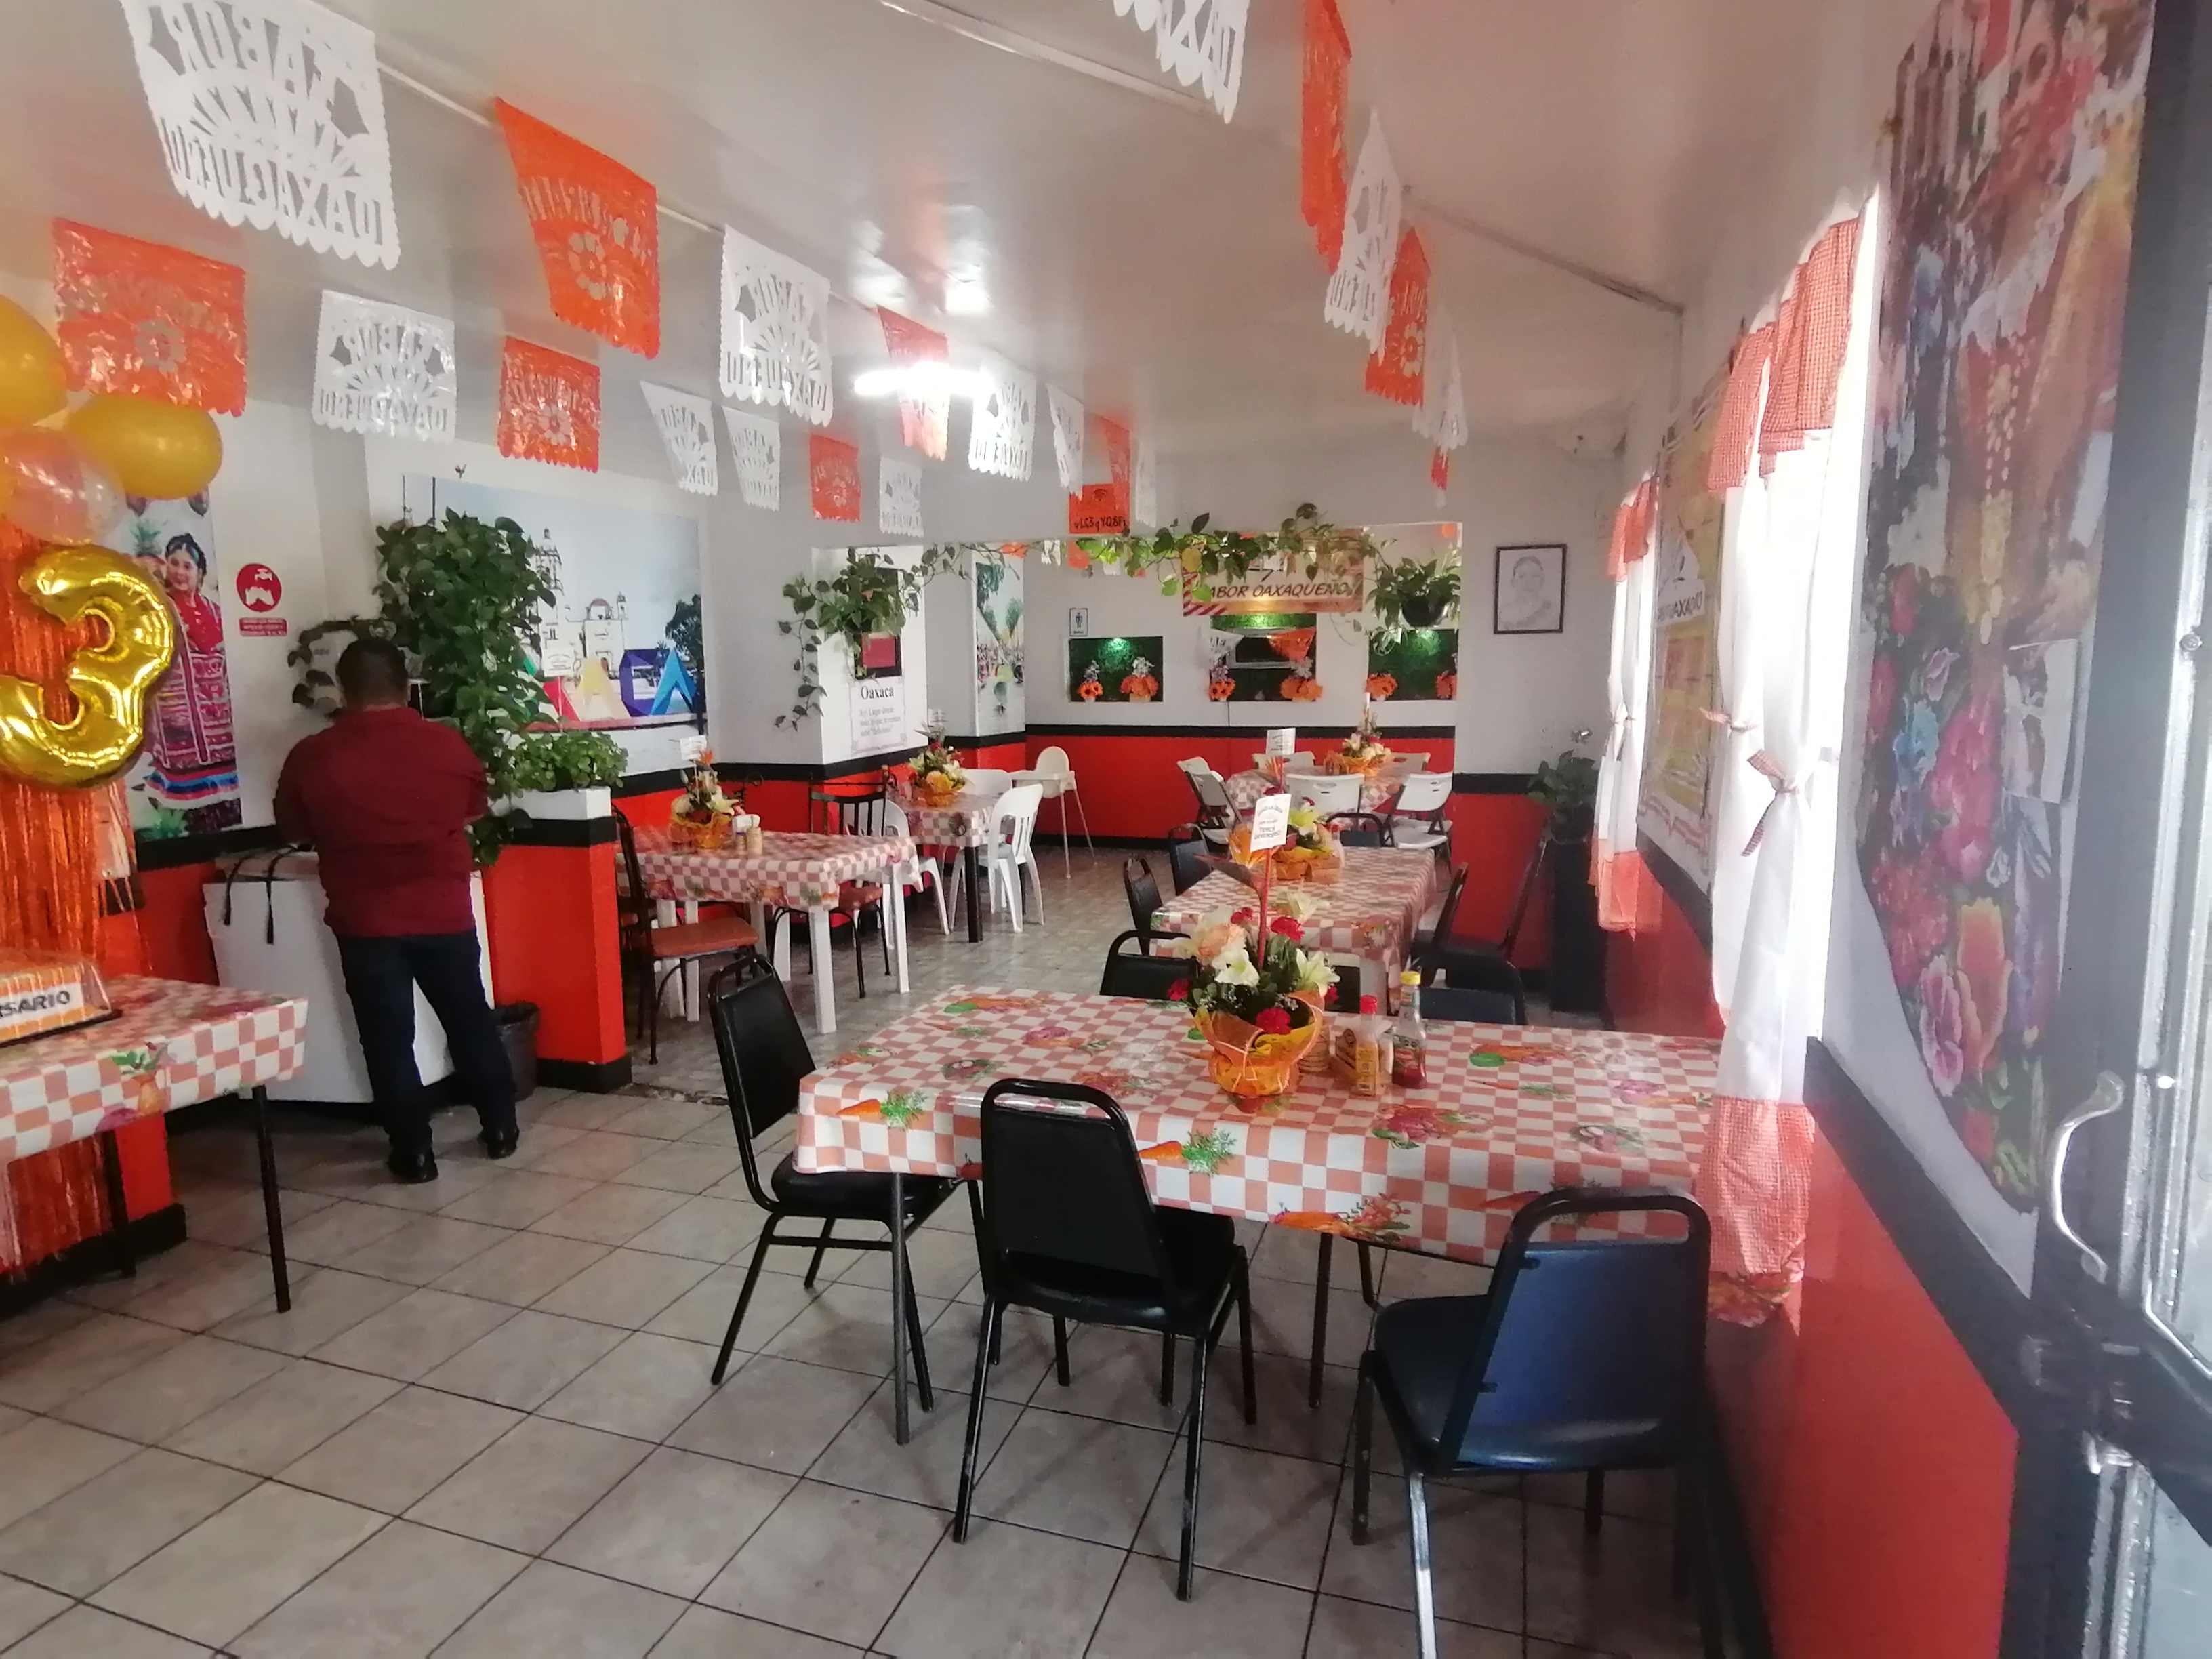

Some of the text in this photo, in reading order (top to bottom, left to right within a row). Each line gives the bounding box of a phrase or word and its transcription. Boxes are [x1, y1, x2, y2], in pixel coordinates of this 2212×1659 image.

[1210, 585, 1249, 598] ABOR
[861, 685, 894, 700] Oaxaca
[0, 990, 70, 1017] SARIO
